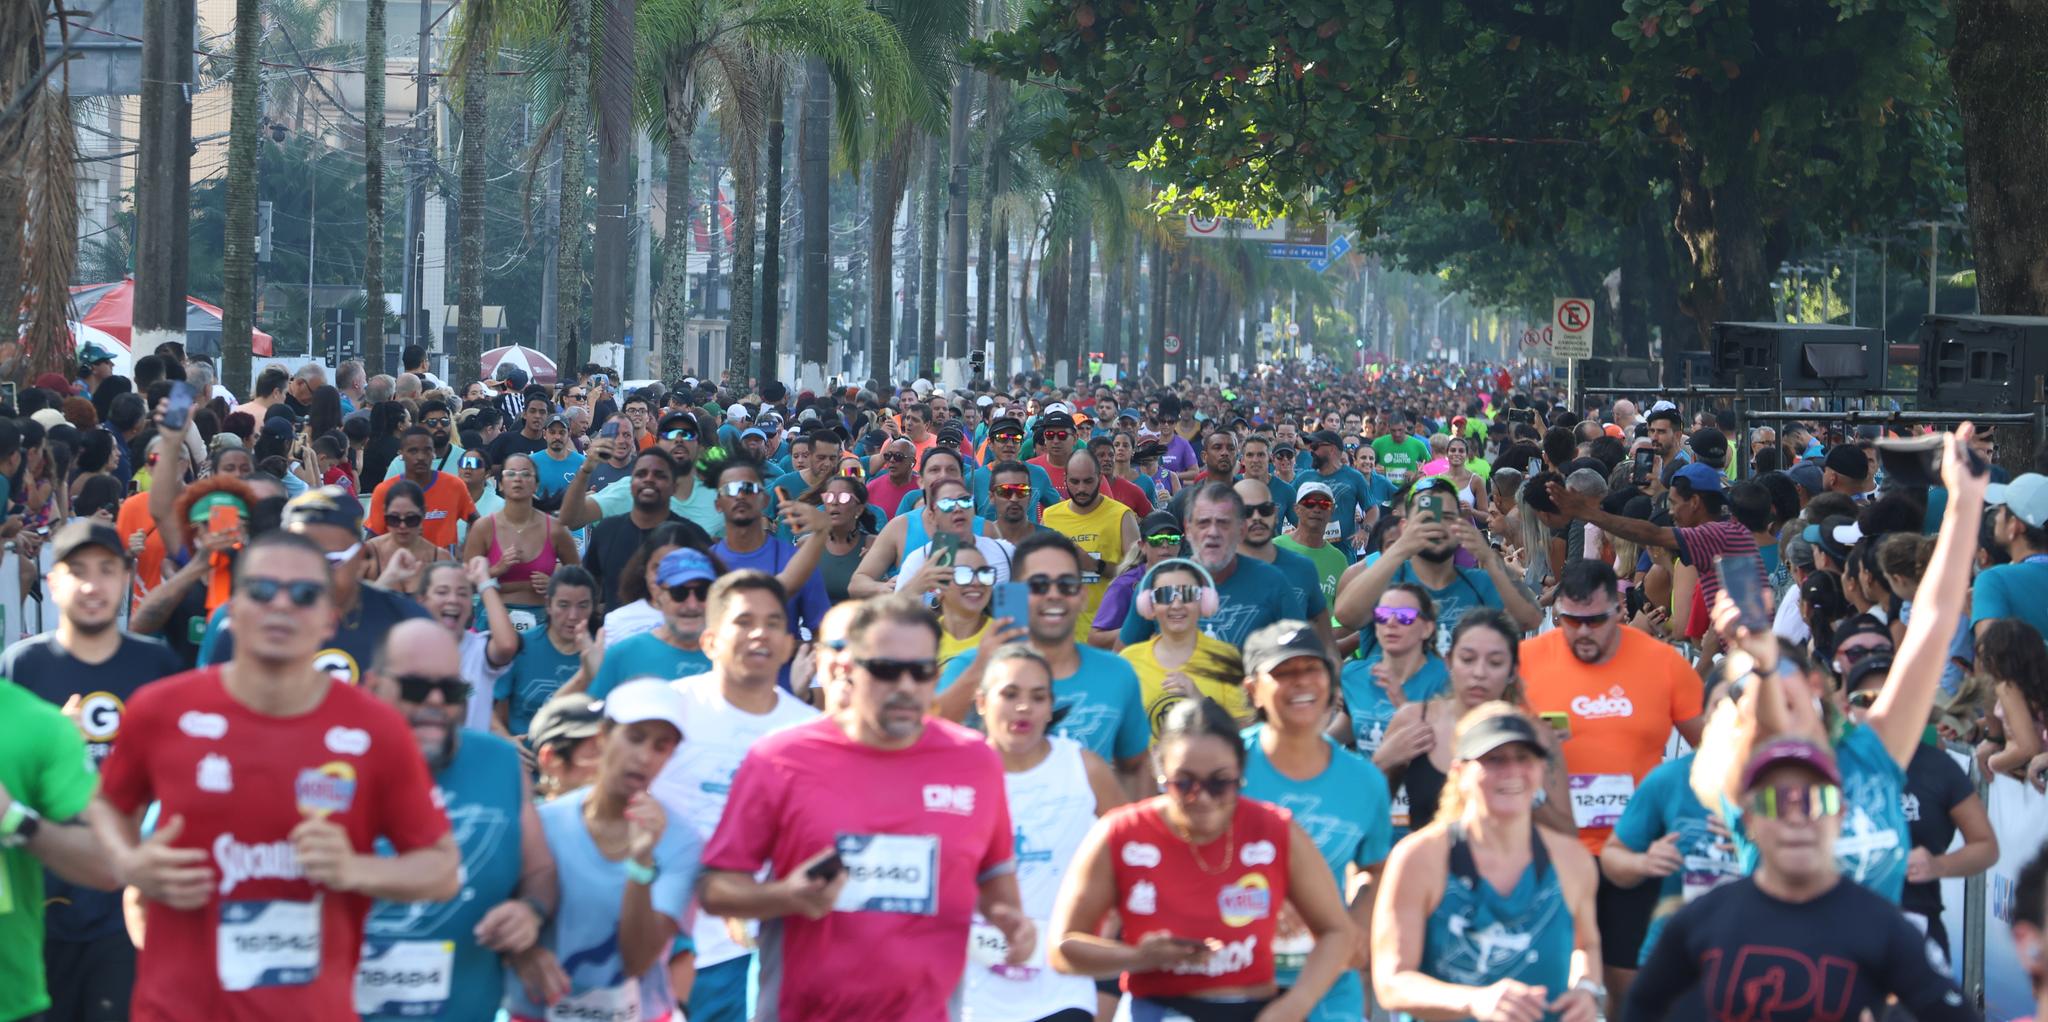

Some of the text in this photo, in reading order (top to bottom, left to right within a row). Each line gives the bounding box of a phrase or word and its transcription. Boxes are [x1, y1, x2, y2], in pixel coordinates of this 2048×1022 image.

[1165, 339, 1178, 347] 50
[511, 622, 529, 631] 61
[1570, 693, 1633, 718] Gelog
[1575, 794, 1630, 807] 12475
